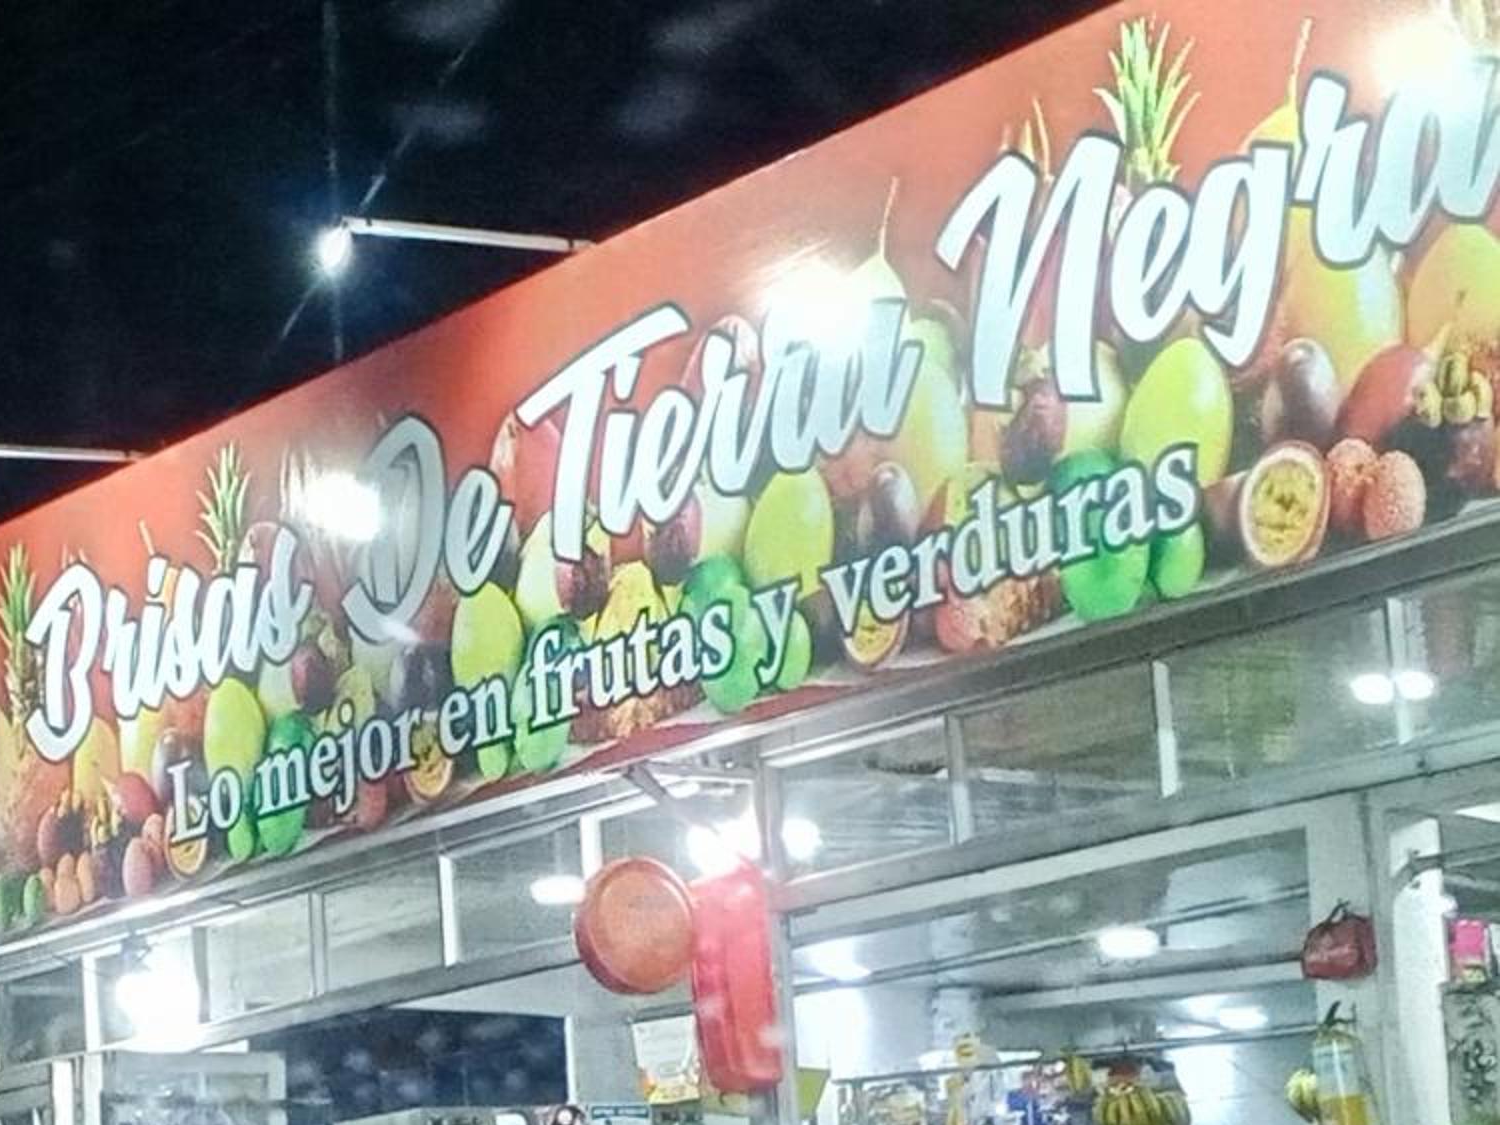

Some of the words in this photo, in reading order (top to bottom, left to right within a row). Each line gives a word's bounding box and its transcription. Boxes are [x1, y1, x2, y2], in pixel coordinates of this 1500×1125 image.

[24, 525, 313, 763] Brisas
[342, 412, 514, 647] De
[514, 298, 924, 562] Tierra
[934, 54, 1500, 410] Negra
[167, 758, 243, 845] Lo
[253, 702, 424, 814] mejor
[437, 674, 514, 749] en
[525, 603, 736, 728] frutas
[751, 578, 803, 686] y
[820, 443, 1200, 632] verduras
